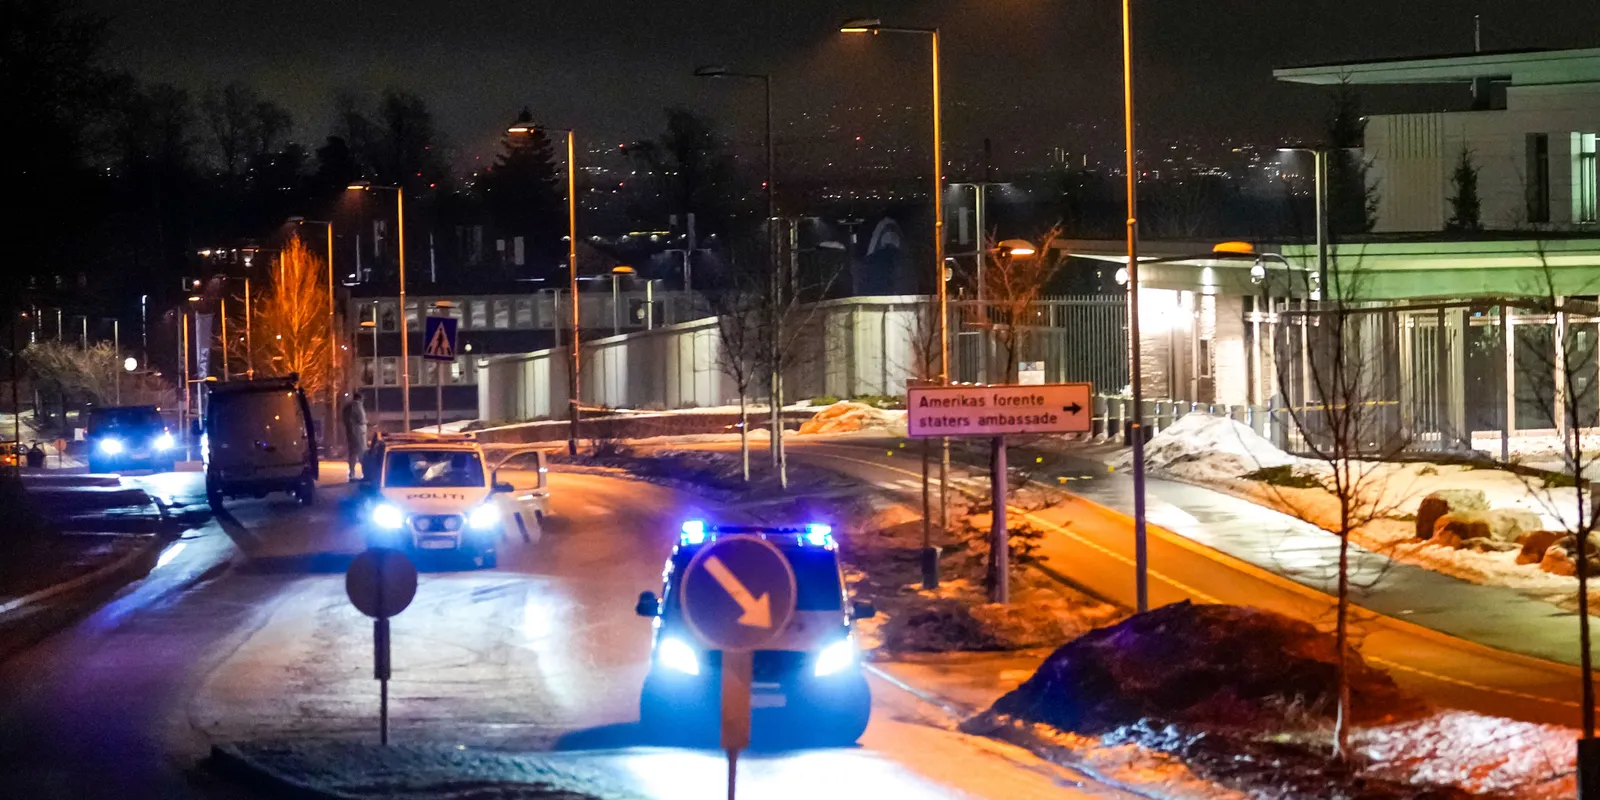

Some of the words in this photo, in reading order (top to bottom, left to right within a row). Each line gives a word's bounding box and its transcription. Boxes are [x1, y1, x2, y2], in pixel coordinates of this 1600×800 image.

[919, 395, 986, 409] Amerikas
[993, 394, 1045, 407] forente
[919, 414, 970, 428] staters
[978, 412, 1058, 427] ambassade
